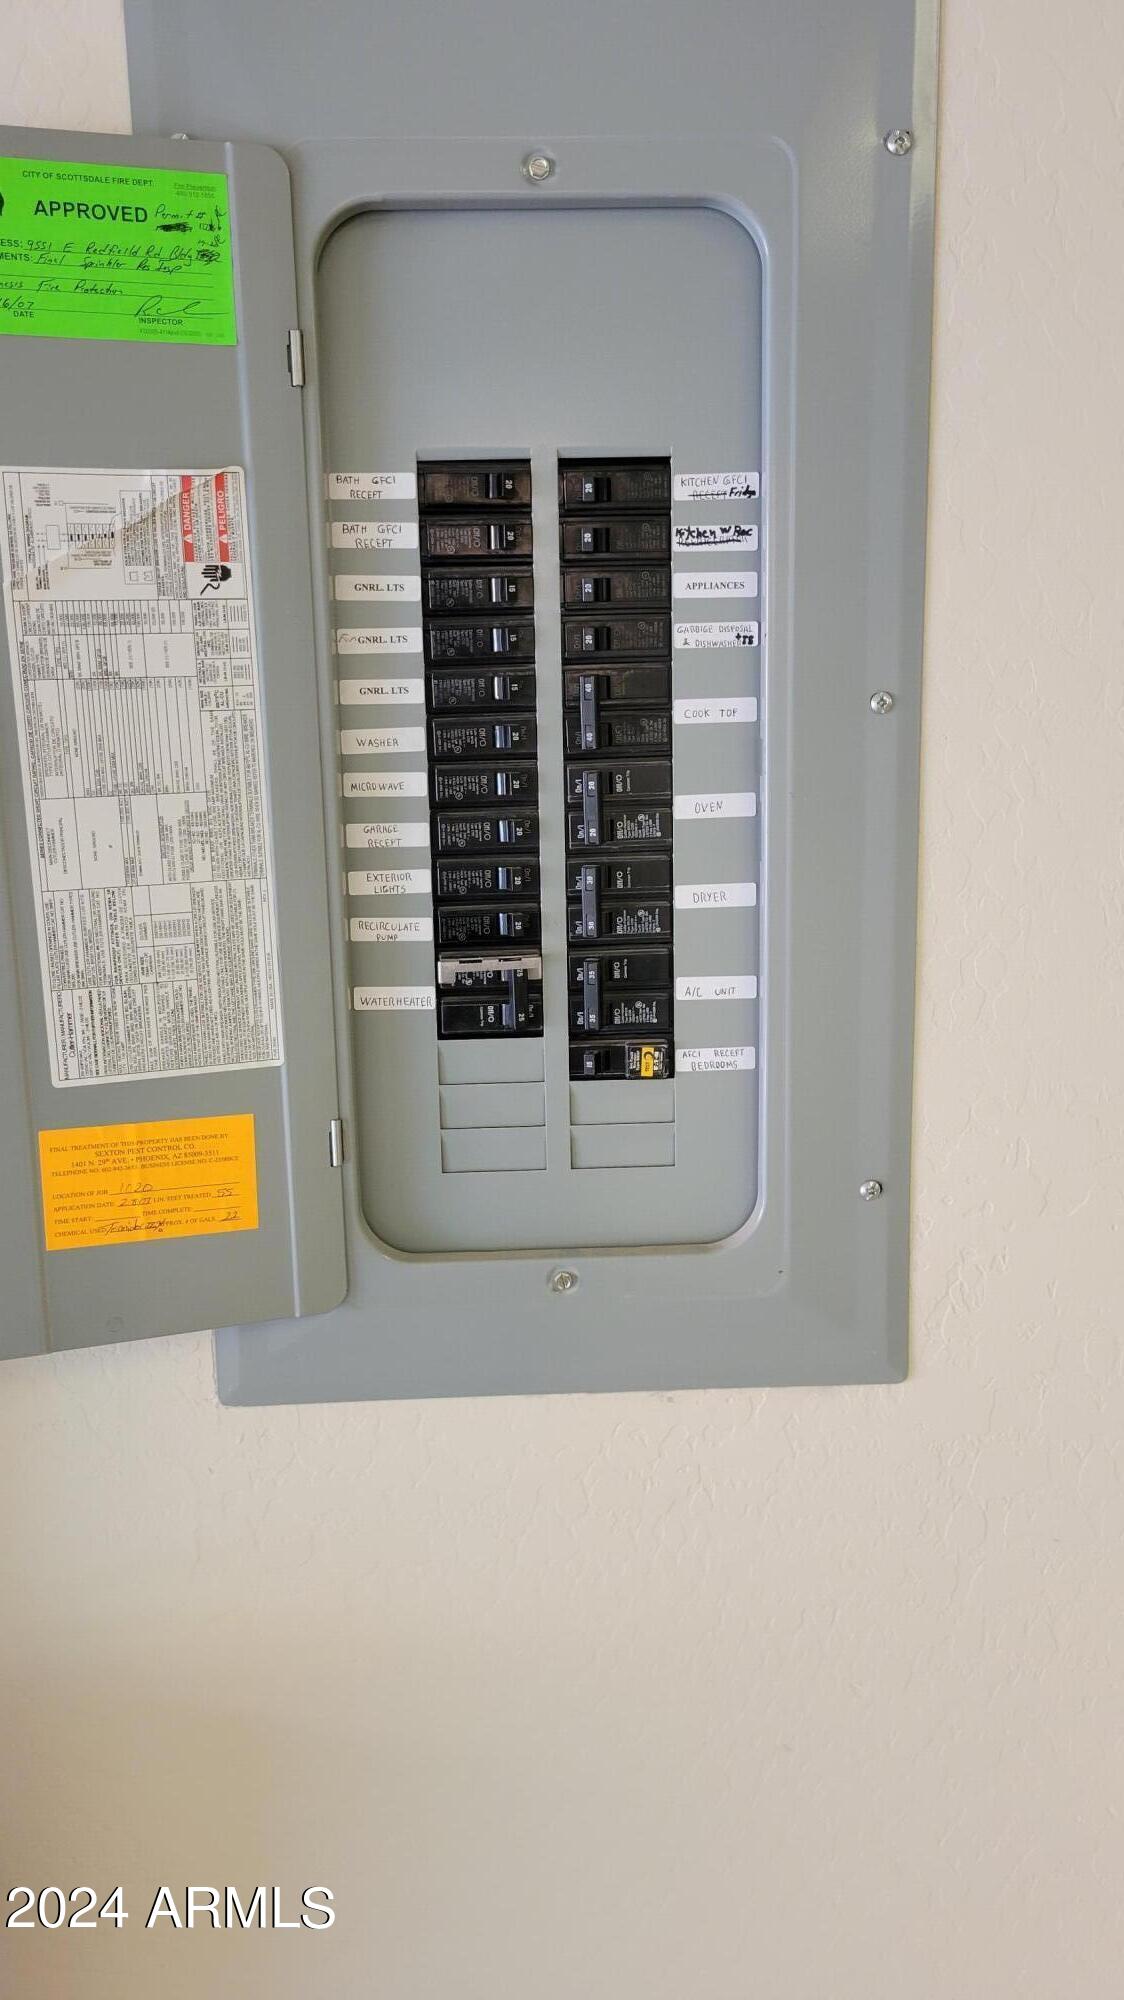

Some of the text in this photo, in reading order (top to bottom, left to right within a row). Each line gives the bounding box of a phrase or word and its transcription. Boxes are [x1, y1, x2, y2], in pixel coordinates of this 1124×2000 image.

[22, 170, 42, 178] CITY
[56, 173, 110, 184] SCOTTSDALE
[112, 177, 130, 186] FIRE
[34, 200, 148, 223] APPROVED
[13, 310, 184, 326] DATE INSPECTOR
[336, 475, 396, 484] BATH GFCI
[505, 479, 513, 490] 20
[680, 474, 747, 488] KITCHEN GFCI
[584, 483, 593, 493] 20
[350, 489, 383, 500] RECEPT
[182, 492, 191, 530] DANGER
[216, 490, 226, 530] PELIGRO
[342, 524, 402, 534] BATH GFCI
[506, 531, 514, 541] 20
[584, 532, 592, 542] 20
[355, 538, 392, 550] RECEPT
[354, 584, 404, 592] GNRL. LTS
[508, 584, 516, 592] 15
[584, 584, 592, 592] 20
[685, 581, 745, 590] APPLIANCES
[358, 635, 408, 644] GNRL. LTS
[509, 634, 517, 642] 15
[586, 634, 592, 644] 20
[392, 686, 409, 694] LTS
[511, 683, 518, 691] 15
[584, 683, 592, 693] 40
[684, 709, 710, 719] COOK
[512, 732, 520, 740] 20
[586, 732, 594, 741] 40
[356, 737, 399, 748] WASHER
[512, 780, 520, 788] 20
[588, 781, 596, 790] 20
[694, 801, 724, 814] OVEN
[363, 825, 398, 834] GARAGE
[516, 827, 524, 836] 20
[590, 828, 596, 838] 20
[368, 838, 402, 848] RECEPT
[366, 872, 412, 882] EXTERIOR
[514, 876, 522, 886] 20
[586, 876, 594, 885] 30
[374, 885, 406, 894] LIGHTS
[692, 891, 727, 905] DRYER
[358, 920, 420, 932] RECIRCULATE
[514, 921, 522, 930] 20
[588, 921, 594, 930] 30
[376, 934, 398, 942] PUMP
[588, 970, 596, 979] 35
[684, 986, 736, 998] A/C UNIT
[518, 1013, 526, 1022] 25
[590, 1014, 596, 1022] 35
[682, 1050, 701, 1059] AFCI
[691, 1060, 738, 1072] BEDROOMS
[94, 1149, 126, 1158] SEXTON
